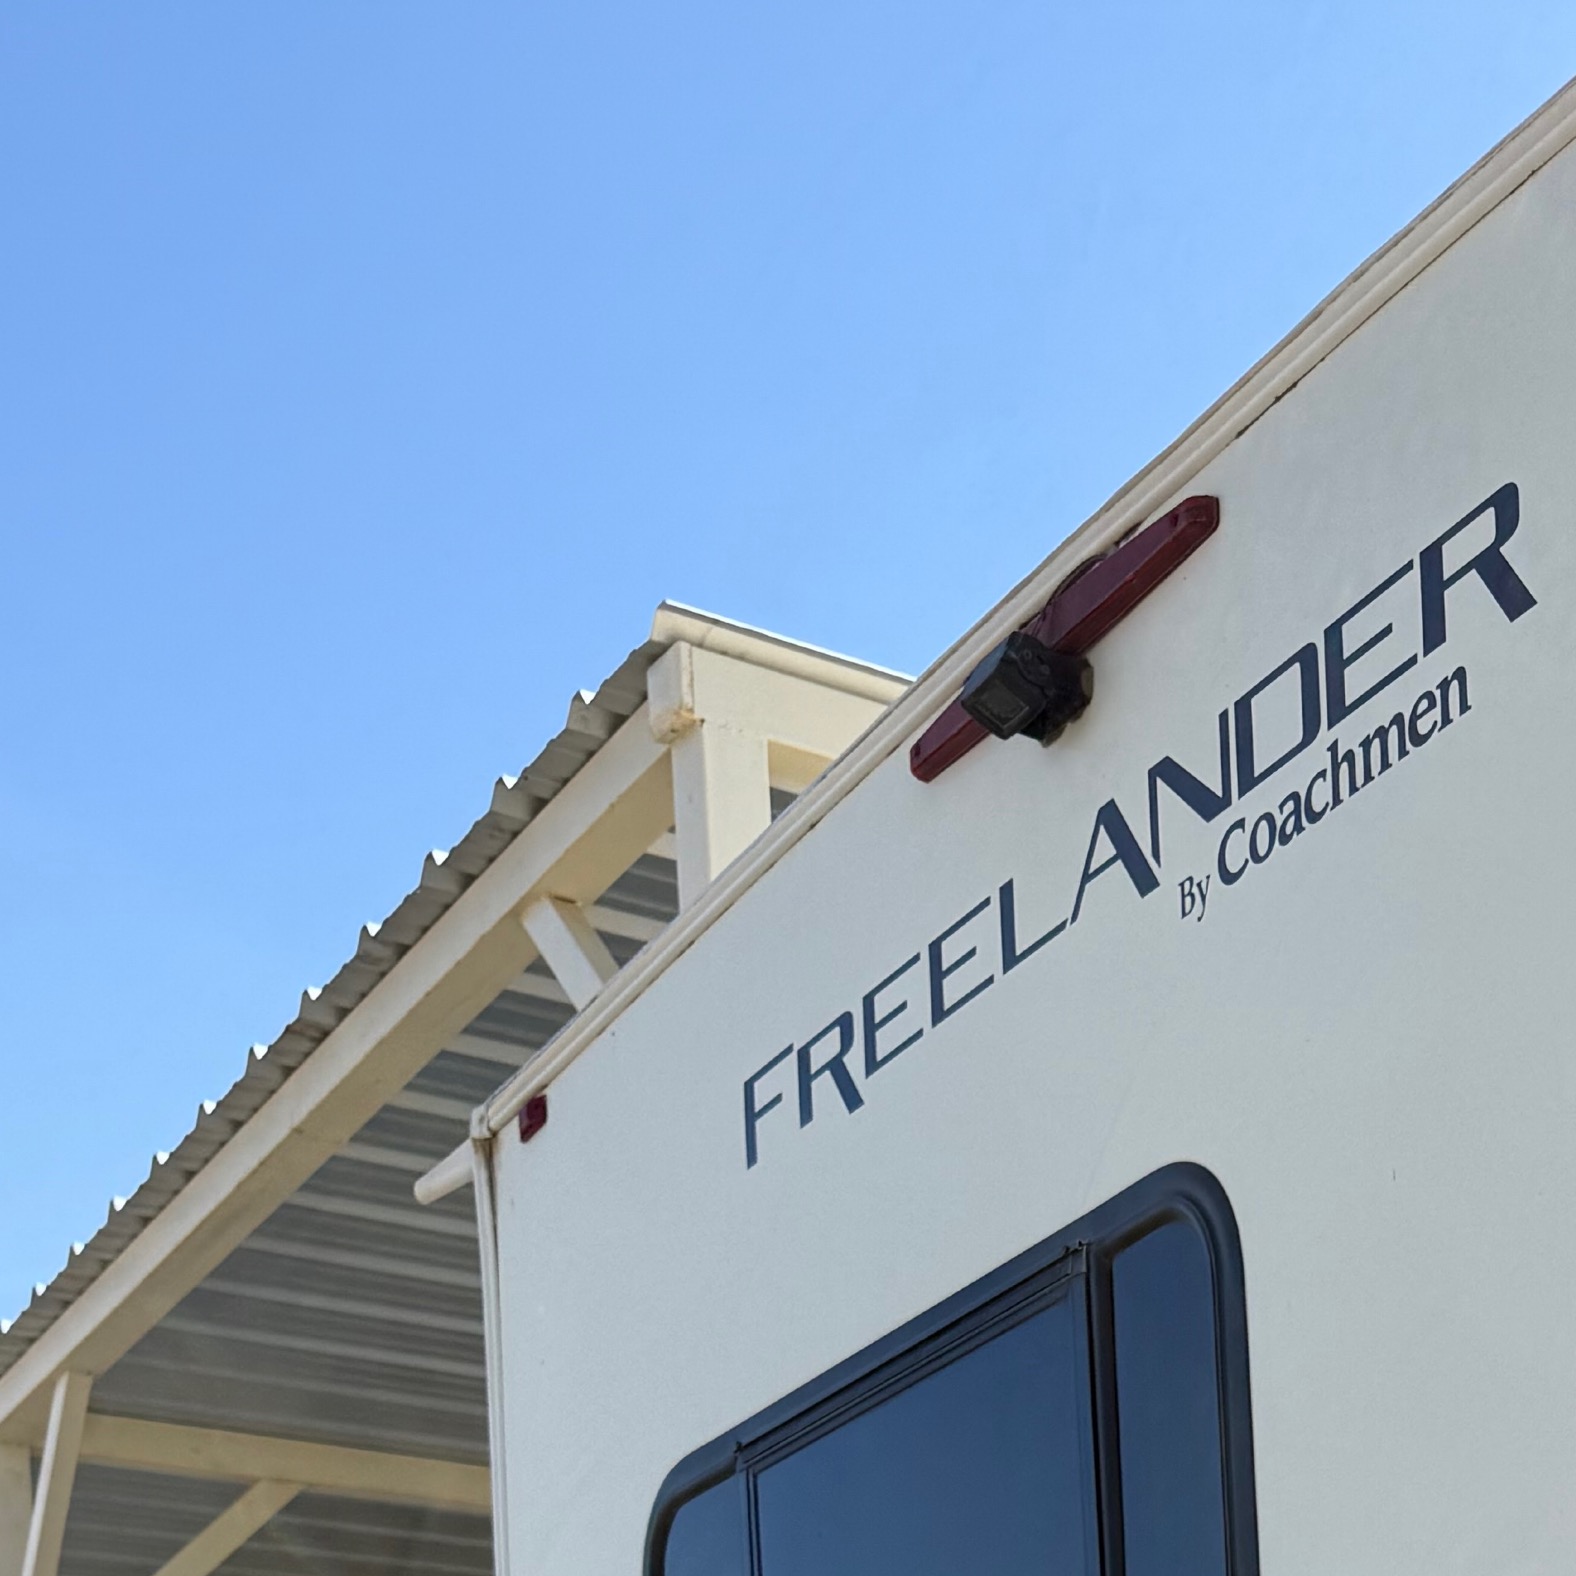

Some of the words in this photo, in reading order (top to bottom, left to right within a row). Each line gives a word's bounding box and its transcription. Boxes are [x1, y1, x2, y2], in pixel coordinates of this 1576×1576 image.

[743, 481, 1538, 1170] FREELANDER
[1178, 874, 1210, 922] By
[1217, 664, 1473, 887] Coachmen
